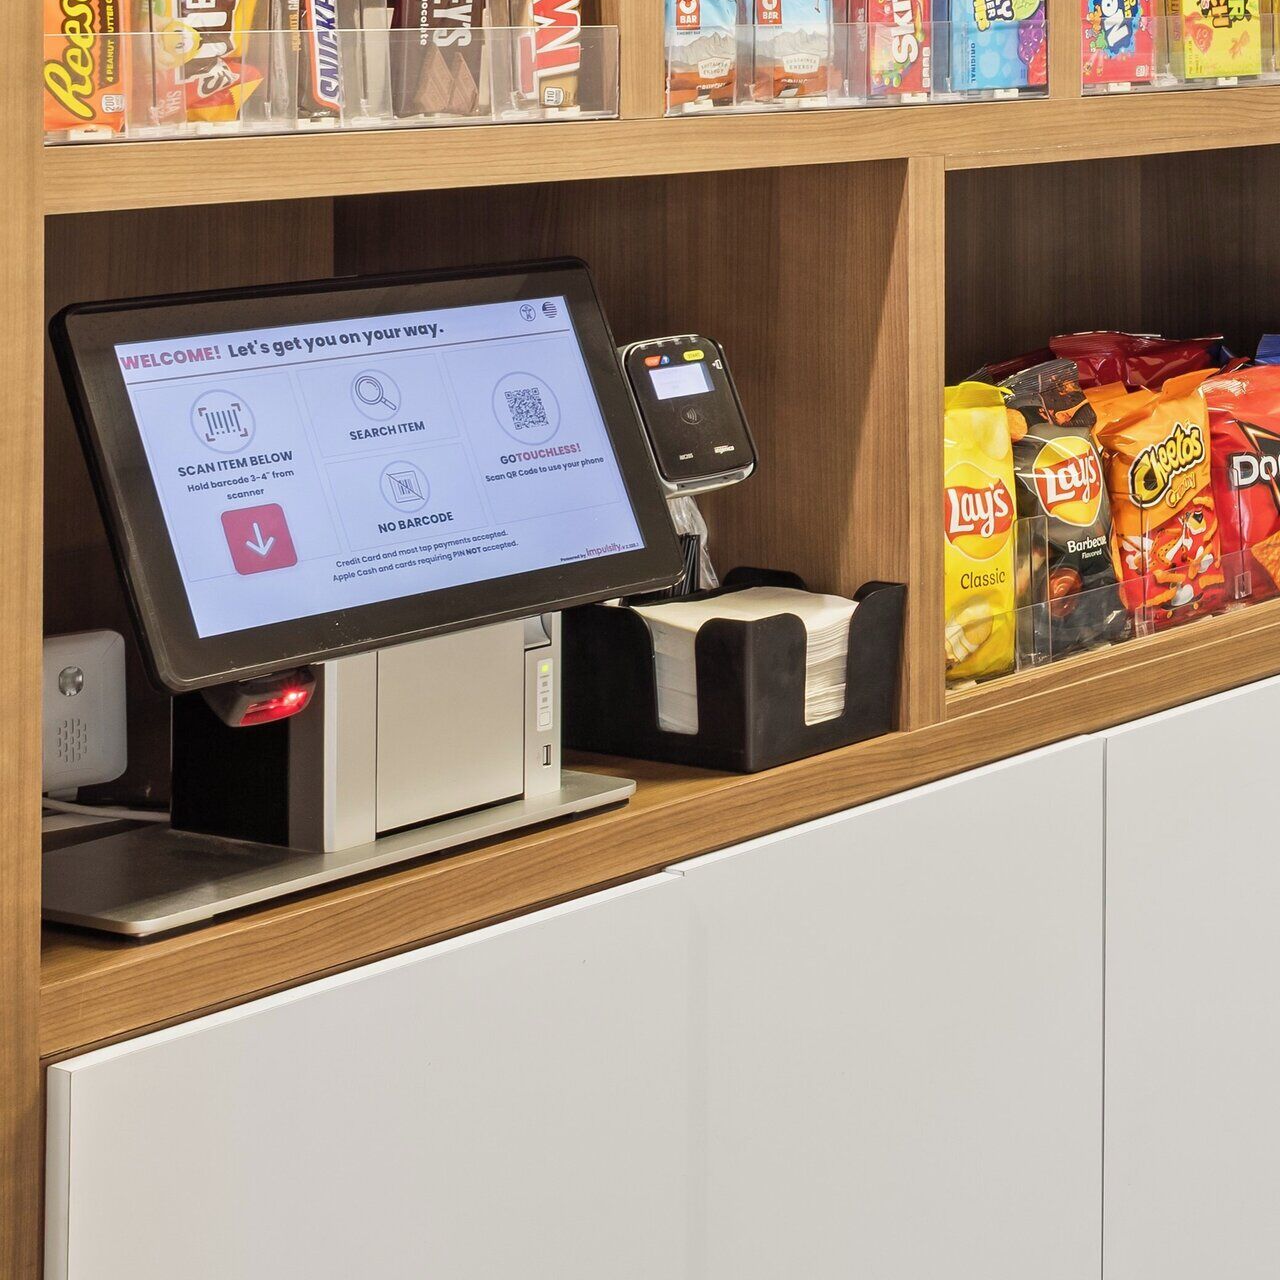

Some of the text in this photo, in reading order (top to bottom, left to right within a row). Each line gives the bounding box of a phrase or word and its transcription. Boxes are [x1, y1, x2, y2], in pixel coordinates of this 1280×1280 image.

[680, 15, 697, 24] BAR
[106, 38, 115, 75] PEANUT
[104, 96, 115, 113] 200
[120, 321, 444, 370] WELCOME! Let's get you on your way.
[349, 421, 426, 441] SEARCH ITEM
[177, 450, 293, 477] SCAN ITEM BELOW
[500, 443, 582, 465] GOTOUCHLESS!
[1132, 426, 1201, 500] Cheetos
[187, 481, 210, 493] Hold
[211, 475, 249, 490] barcode
[271, 468, 295, 480] from
[485, 456, 605, 483] Scan QR Code to use your phone
[1042, 452, 1098, 504] Lay's
[226, 487, 265, 501] scanner
[378, 511, 454, 534] NO BARCODE
[947, 482, 1009, 539] Lay's
[336, 529, 509, 568] Credit Card and most tap payments accepted.
[1067, 535, 1107, 554] Barbecue
[333, 541, 519, 583] Apple Cash and cards requiring PIN NOT accepted.
[960, 568, 1006, 589] Classic
